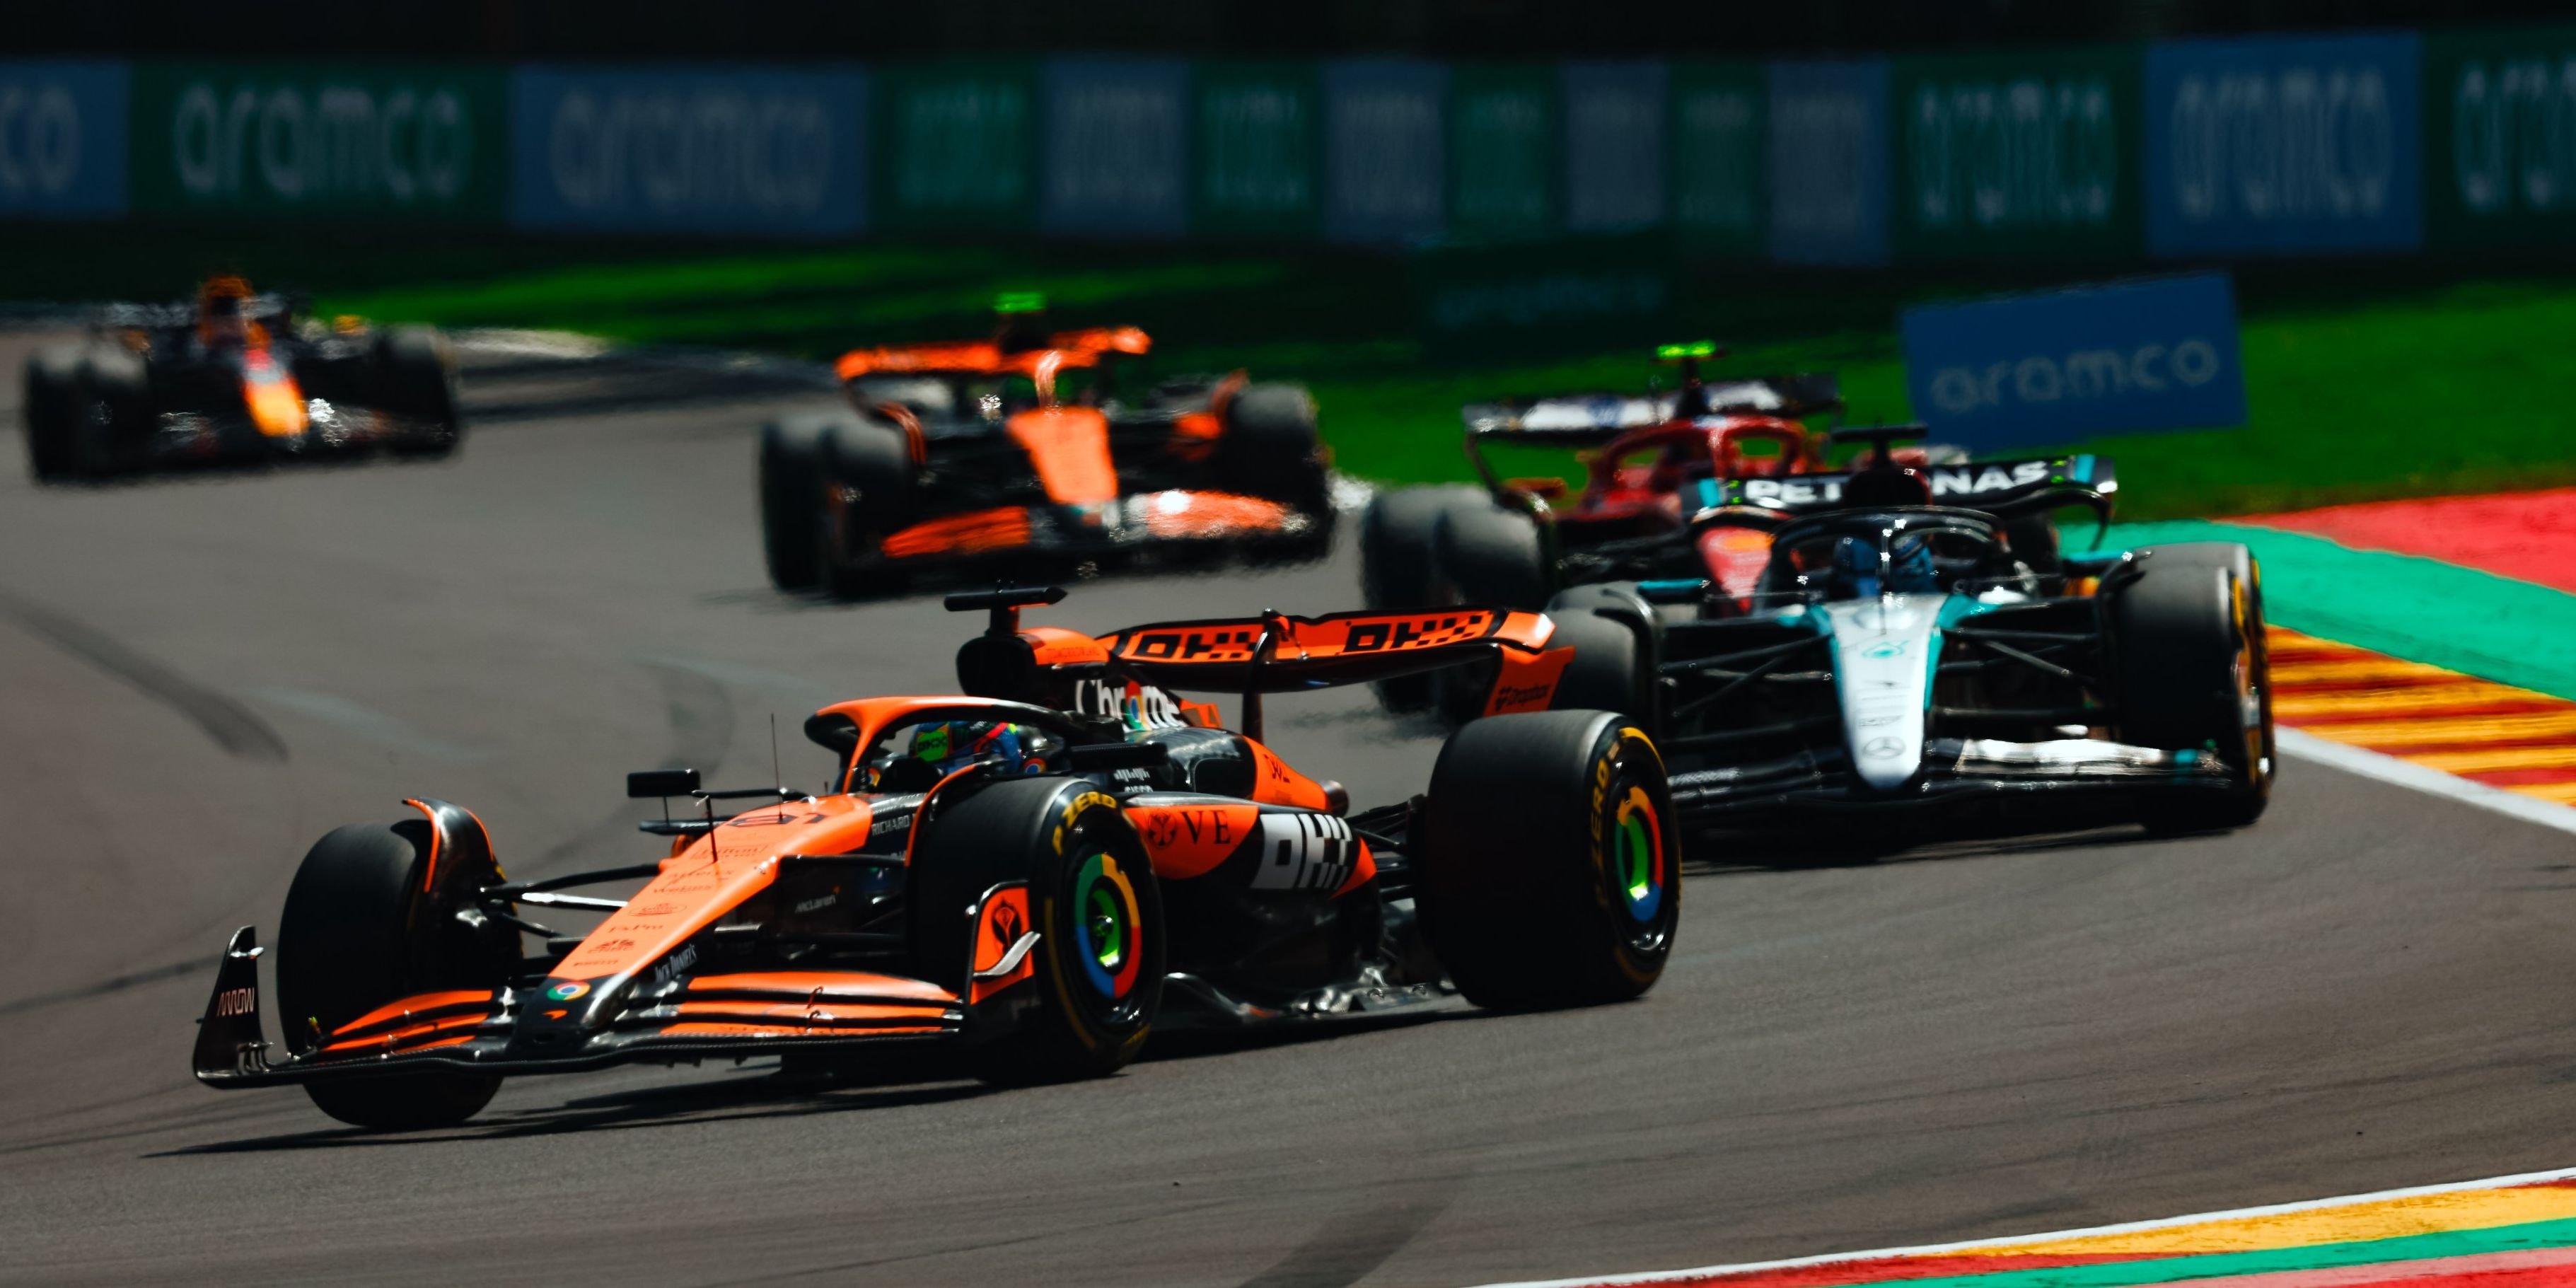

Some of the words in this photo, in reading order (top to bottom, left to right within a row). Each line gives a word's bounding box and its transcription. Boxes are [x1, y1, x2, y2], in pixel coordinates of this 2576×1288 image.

[173, 82, 475, 199] aramco
[1930, 340, 2221, 414] aramco
[871, 815, 910, 837] RICHARD
[216, 986, 255, 1017] ARROW
